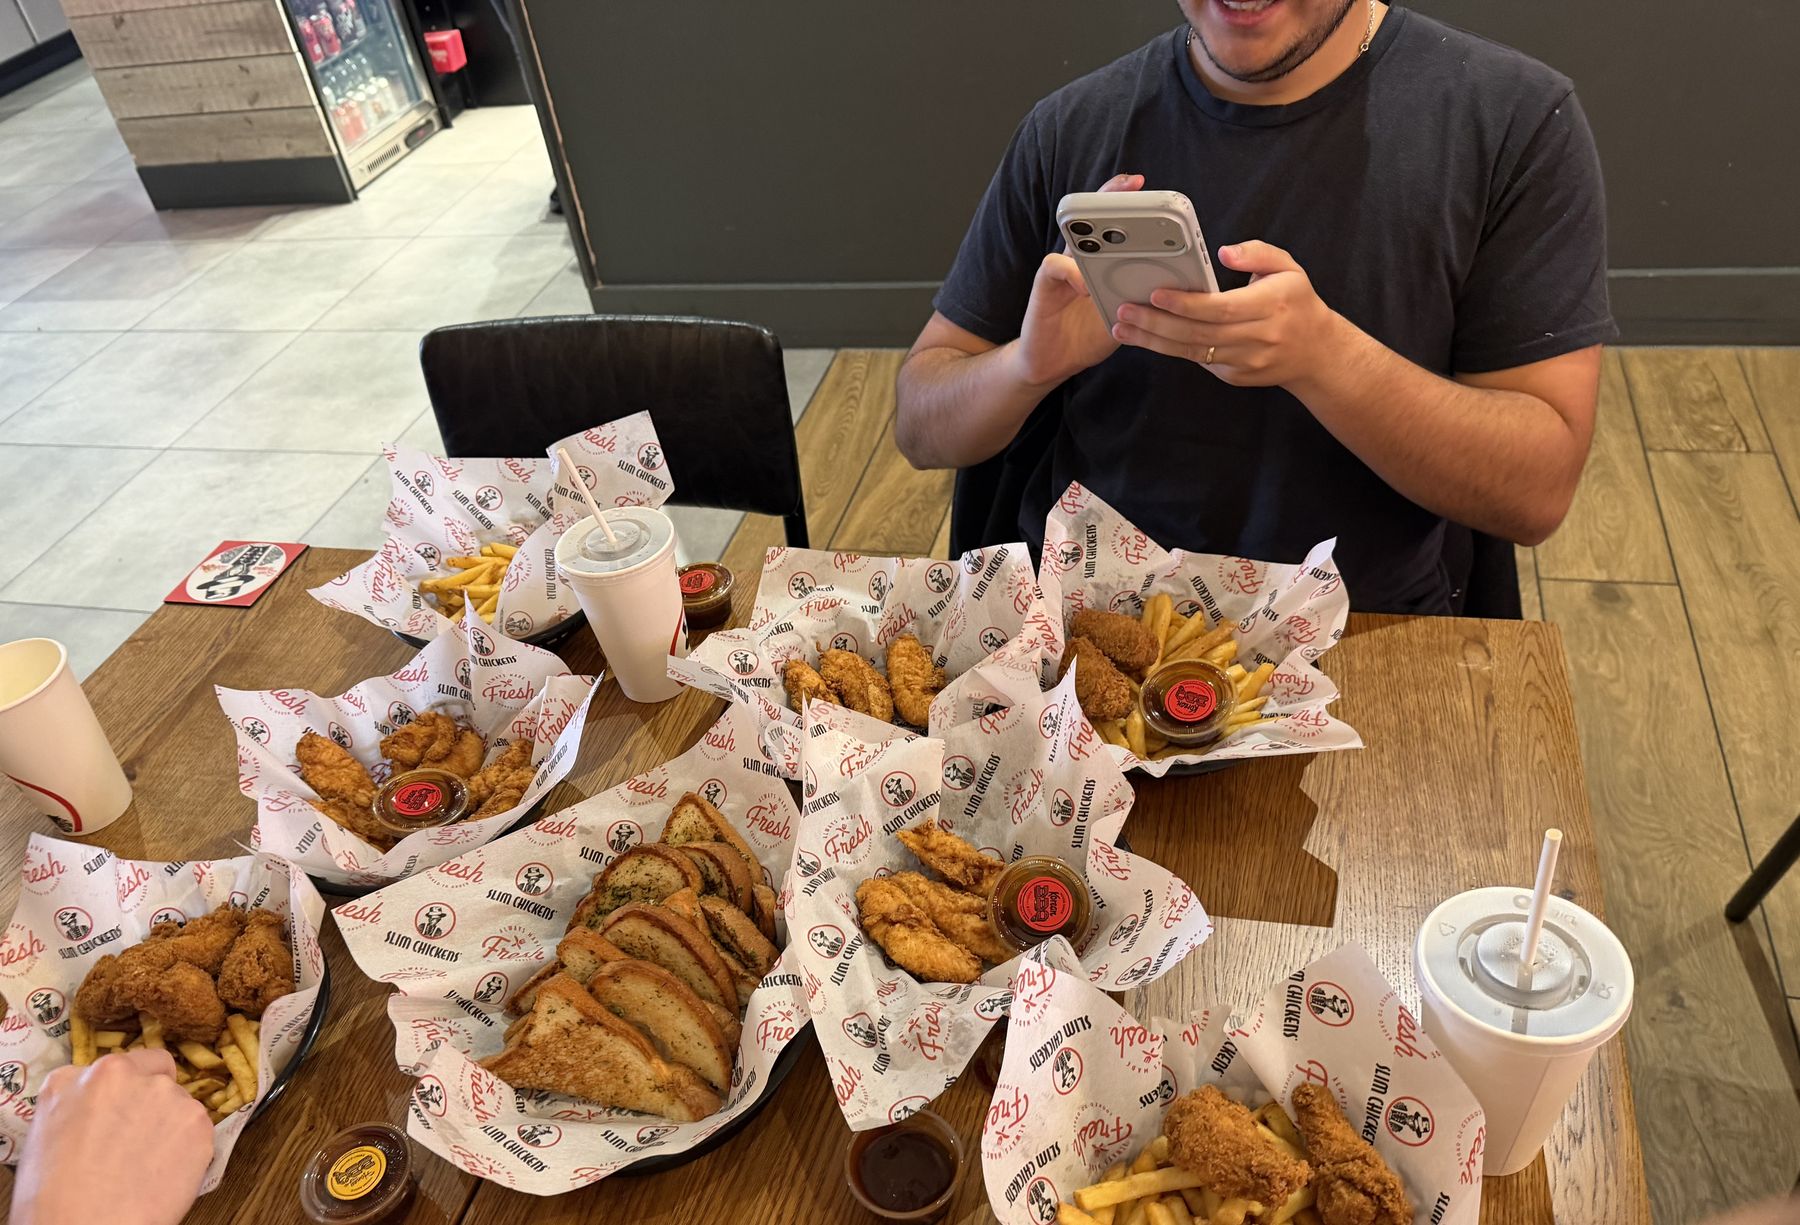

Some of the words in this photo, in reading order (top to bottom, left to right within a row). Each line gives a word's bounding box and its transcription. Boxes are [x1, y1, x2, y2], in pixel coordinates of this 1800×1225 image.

[584, 428, 616, 453] resh
[504, 458, 534, 483] resh
[617, 459, 635, 475] SLIM
[636, 468, 668, 491] CHICKENS
[395, 470, 411, 487] SLIM
[409, 486, 435, 515] CHICKENS
[525, 492, 541, 511] SLIM
[554, 482, 569, 497] SLIM
[1060, 482, 1084, 515] Fre
[452, 490, 468, 506] SLIM
[467, 504, 496, 530] CHICKENS
[1085, 523, 1097, 559] CHICKENS
[1125, 527, 1148, 565] Fre
[371, 560, 394, 604] Fresh
[972, 580, 988, 601] SLIM
[984, 545, 1010, 582] CHICKENS
[1084, 560, 1095, 579] SLIM
[860, 605, 880, 614] SLIM
[928, 601, 947, 618] SLIM
[1191, 575, 1215, 613] CHICKENS
[752, 609, 777, 631] esh
[878, 603, 917, 648] Fresh
[393, 662, 429, 682] resh
[479, 655, 517, 667] CHICKENS
[437, 683, 458, 696] SLIM
[482, 681, 534, 702] Fresh
[1267, 671, 1315, 696] Fresh
[269, 688, 309, 717] resh
[342, 692, 367, 713] resh
[810, 724, 827, 739] SLIM
[979, 707, 1011, 735] Fre
[704, 728, 736, 752] resh
[1049, 736, 1059, 763] SLIM
[1068, 720, 1094, 761] Fre
[547, 743, 568, 775] CHICKENS
[743, 757, 761, 773] SLIM
[840, 740, 892, 780] Fresh
[626, 778, 668, 798] resh
[964, 793, 983, 818] SLIM
[979, 752, 1001, 797] CHICKENS
[1011, 768, 1043, 825] Fresh
[1076, 777, 1096, 823] CHICKENS
[809, 791, 841, 814] CHICKENS
[883, 813, 906, 835] SLIM
[904, 790, 942, 819] CHICKENS
[534, 817, 578, 838] resh
[746, 805, 791, 840] Fresh
[824, 814, 873, 862] Fresh
[1071, 824, 1086, 848] SLIM
[23, 853, 66, 884] resh
[83, 853, 106, 875] SLIM
[437, 859, 485, 883] resh
[579, 846, 604, 864] SLIM
[1093, 838, 1131, 881] Fre
[118, 863, 150, 902] resh
[335, 901, 384, 924] resh
[486, 889, 512, 905] SLIM
[512, 896, 557, 921] CHICKENS
[1031, 885, 1049, 922] BBQ
[1048, 891, 1060, 917] Korean
[1138, 889, 1153, 936] CHICKENS
[0, 930, 46, 967] resh
[58, 946, 78, 959] SLIM
[77, 924, 122, 954] CHICKENS
[384, 930, 412, 950] SLIM
[412, 940, 462, 963] CHICKENS
[482, 936, 545, 960] Fresh
[830, 961, 850, 986] SLIM
[1150, 936, 1178, 980] CHICKENS
[757, 974, 803, 989] HICKENS
[1012, 964, 1056, 1002] Fre
[759, 1000, 786, 1018] ALWAYS
[790, 1003, 808, 1018] MADE
[1283, 986, 1304, 1040] CHICKENS
[756, 1017, 795, 1051] Fre
[917, 1001, 947, 1060] Fresh
[1064, 1015, 1092, 1038] SLIM
[1110, 1025, 1160, 1058] resh
[1394, 1004, 1427, 1061] resh
[872, 1053, 891, 1075] SLIM
[1029, 1030, 1063, 1072] CHICKENS
[1211, 1038, 1239, 1077] CKENS
[837, 1059, 863, 1106] esh
[1373, 1063, 1391, 1096] SLIM
[983, 1087, 1029, 1135] Fre
[479, 1125, 502, 1143] SLIM
[502, 1140, 550, 1173] CHICKENS
[600, 1130, 627, 1152] SLIM
[1036, 1141, 1061, 1168] SLIM
[1073, 1116, 1133, 1166] Fresh
[1004, 1161, 1036, 1209] CHICKENS
